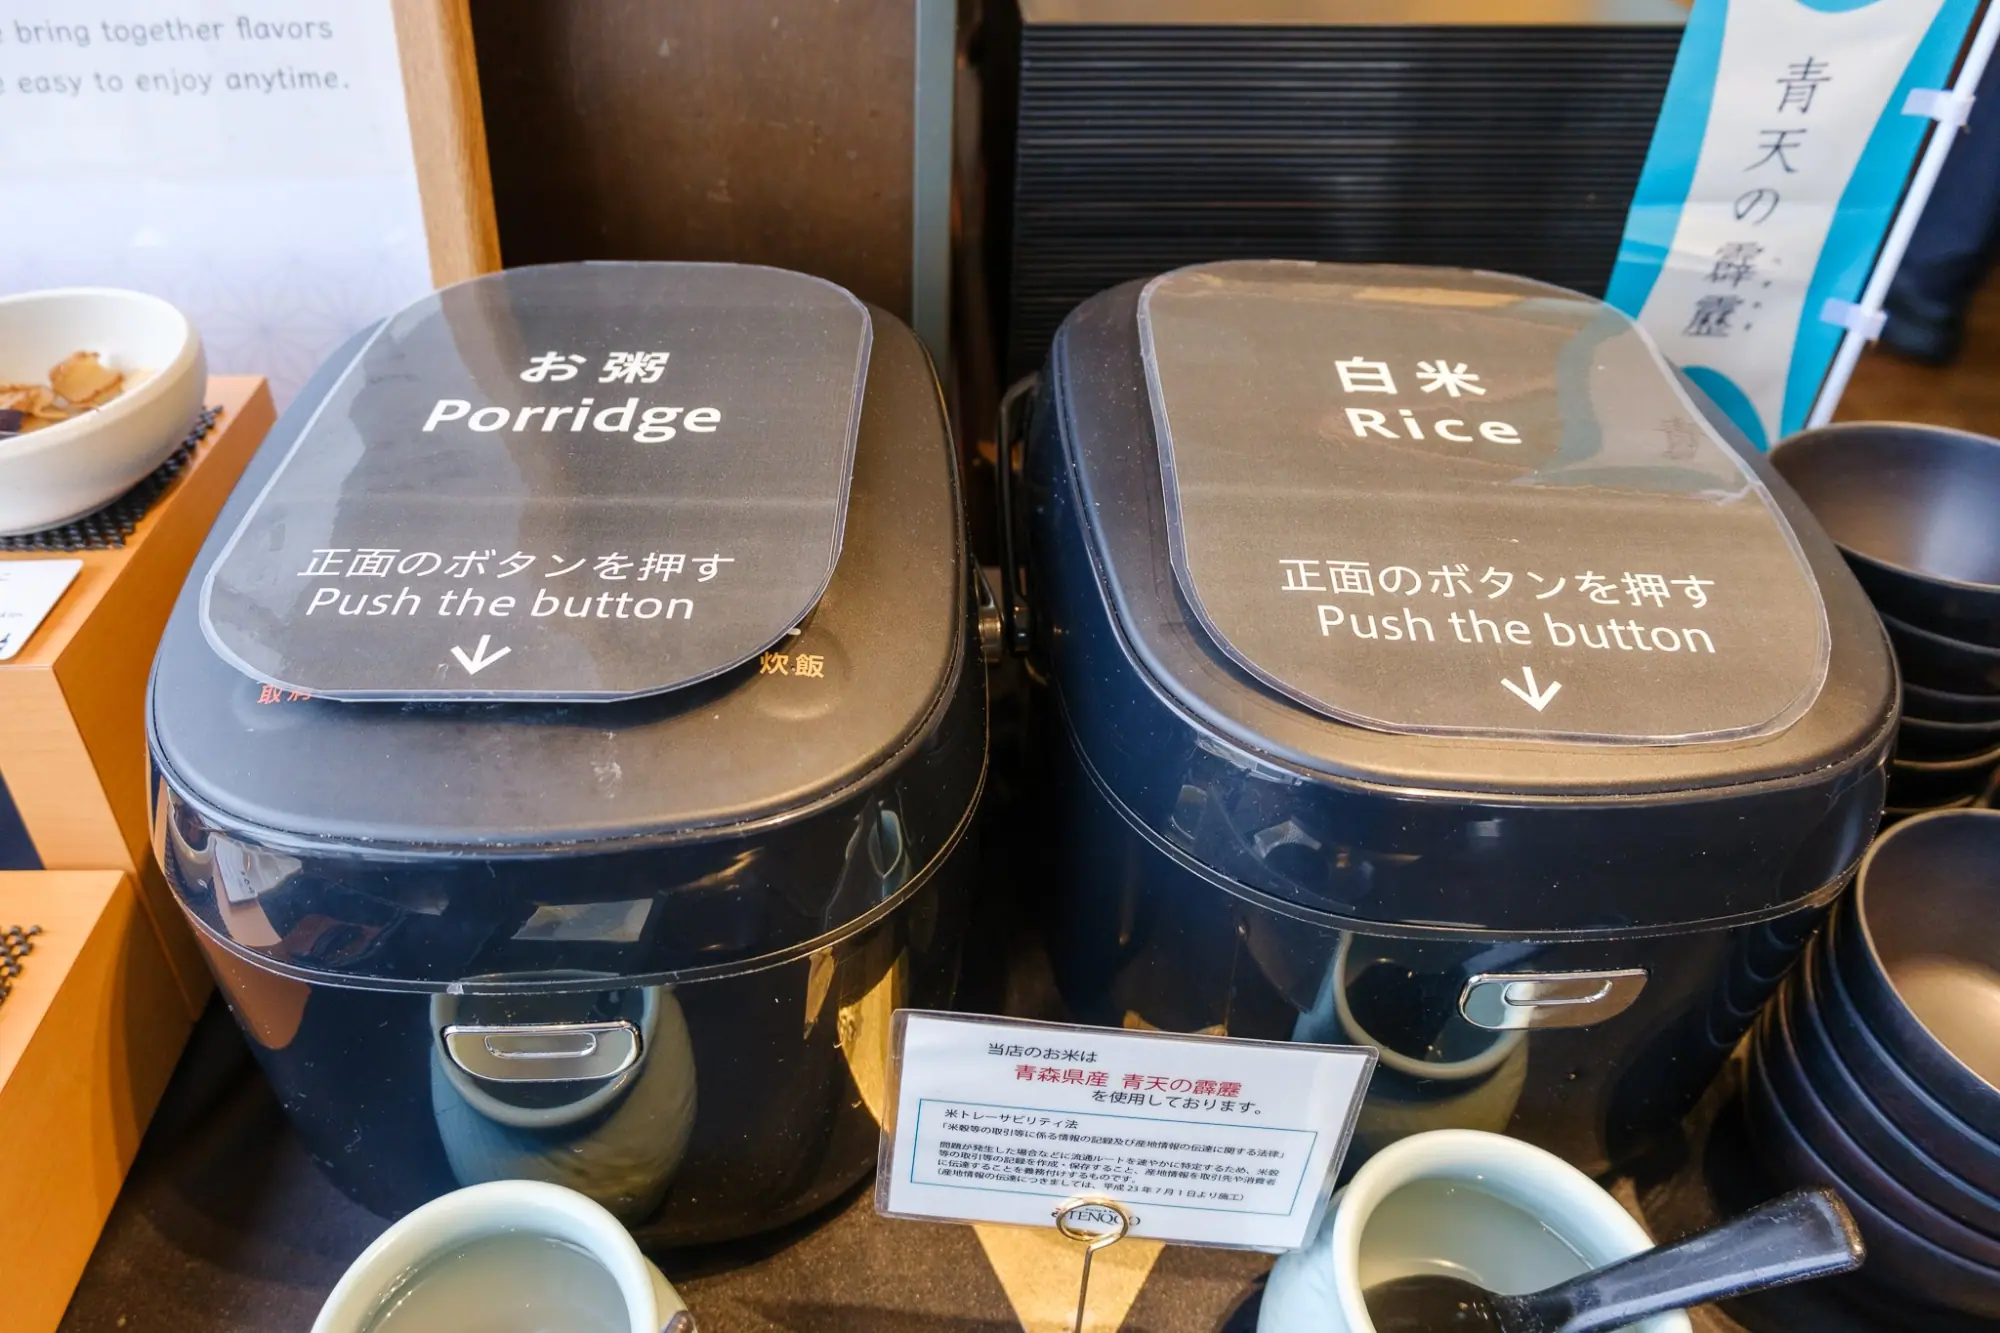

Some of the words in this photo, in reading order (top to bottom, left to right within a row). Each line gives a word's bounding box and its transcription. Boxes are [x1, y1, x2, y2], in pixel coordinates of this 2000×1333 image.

[14, 19, 91, 47] bring
[101, 18, 225, 46] together
[236, 16, 333, 41] flavors
[18, 72, 82, 97] easy
[95, 71, 124, 93] to
[136, 67, 213, 96] enjoy
[226, 66, 350, 94] anytime.
[422, 397, 722, 444] Porridge
[1345, 408, 1522, 444] Rice
[297, 548, 735, 583] 正面のボタンを押す
[1279, 558, 1716, 609] 正面のボタンを押す
[305, 586, 420, 617] Push
[438, 588, 517, 617] the
[530, 588, 694, 620] button
[1317, 604, 1435, 642] Push
[1447, 609, 1531, 645] the
[1545, 612, 1717, 654] button
[760, 651, 824, 678] 炊飯
[988, 1042, 1098, 1063] 当店のお米は
[1014, 1064, 1109, 1087] 青森県産
[1122, 1073, 1242, 1098] 青天の霹靂
[945, 1108, 1078, 1130] 米トレーサビリティ法
[1092, 1090, 1261, 1115] を使用しております。
